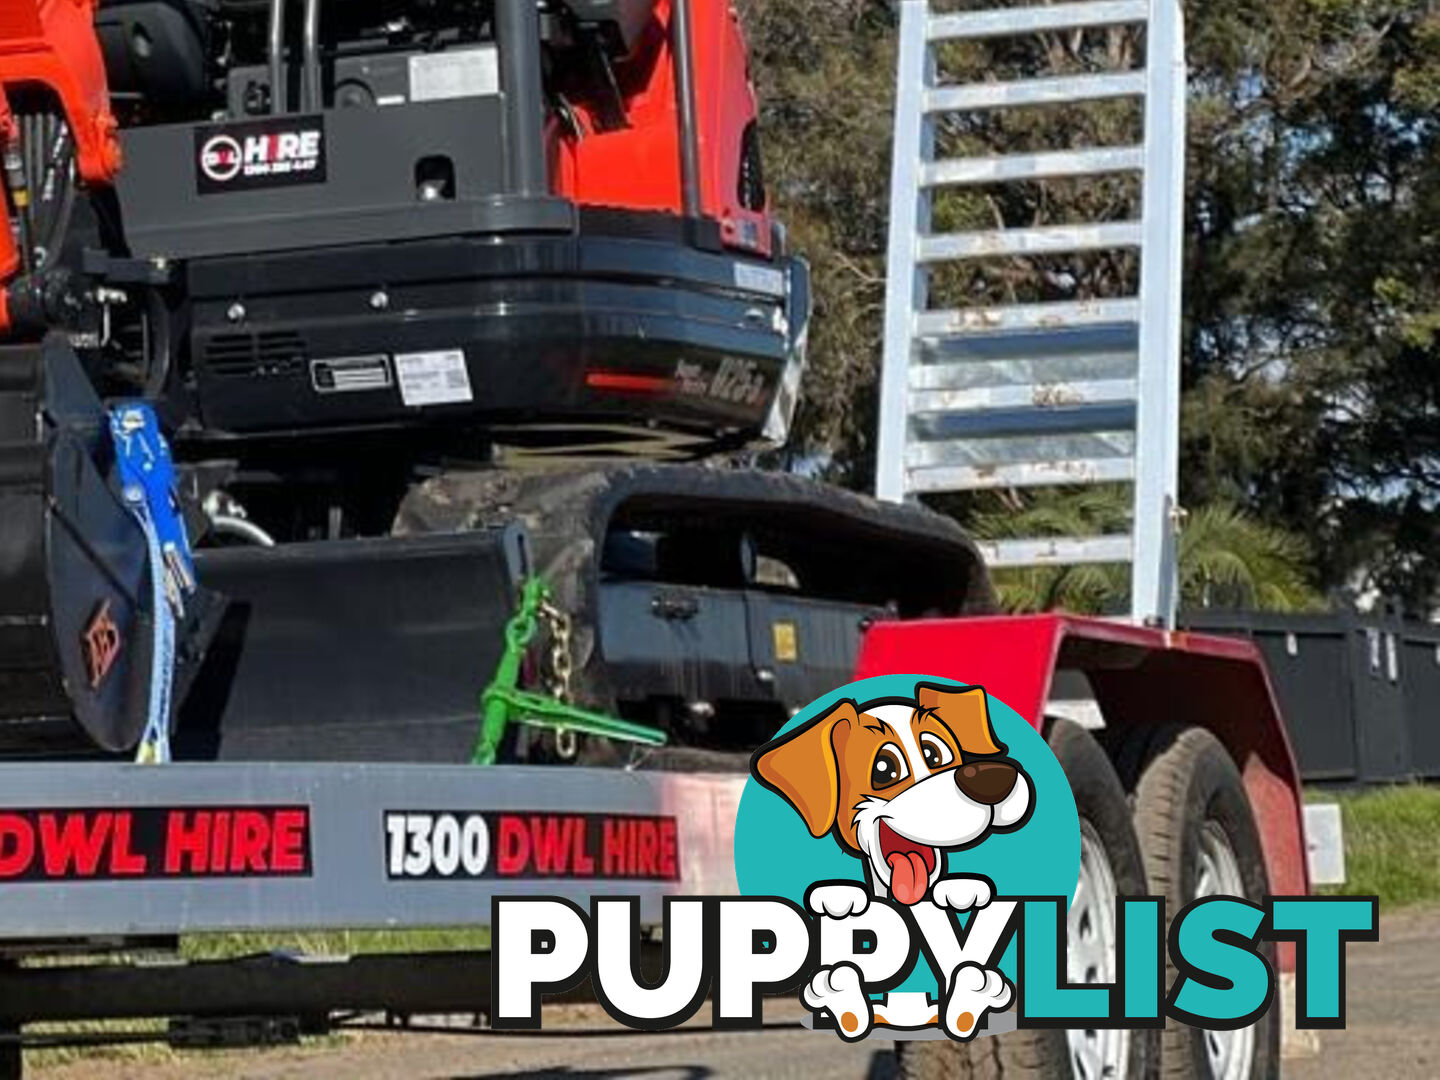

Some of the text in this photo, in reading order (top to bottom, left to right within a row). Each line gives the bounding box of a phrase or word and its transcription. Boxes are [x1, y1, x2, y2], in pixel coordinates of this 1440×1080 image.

[244, 130, 319, 163] HIRE
[164, 811, 306, 873] HIRE
[387, 814, 677, 877] 1300 DWL HIRE
